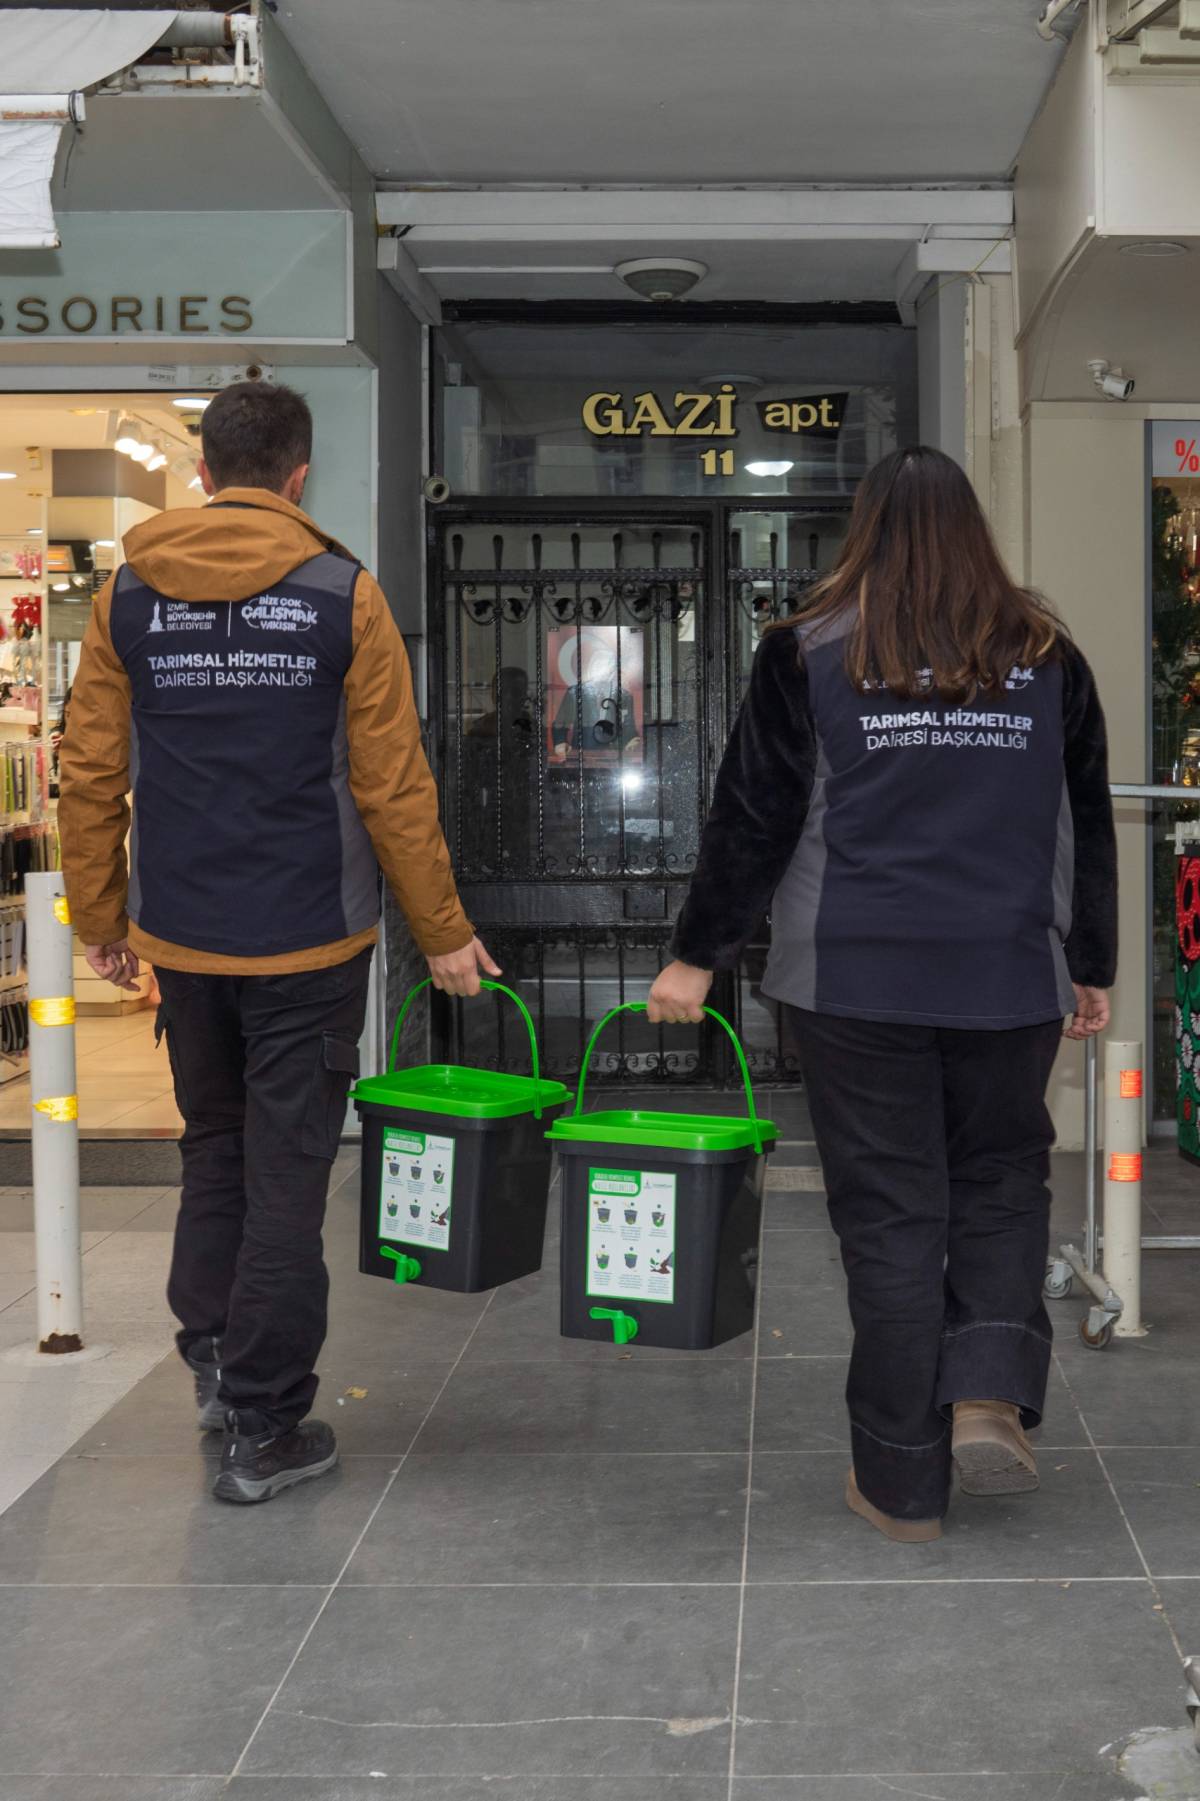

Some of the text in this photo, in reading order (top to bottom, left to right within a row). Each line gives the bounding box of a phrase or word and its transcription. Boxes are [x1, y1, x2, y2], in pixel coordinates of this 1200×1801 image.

[0, 296, 253, 333] SORIES
[582, 384, 840, 436] GAZİ apt.
[700, 449, 734, 476] 11
[167, 602, 189, 611] İZMİR
[258, 594, 302, 609] BİZE ÇOK
[167, 610, 216, 622] BÜYÜKŞEHİR
[241, 606, 318, 624] ÇALIŞMAK
[167, 621, 212, 631] BELEDİYESİ
[260, 621, 297, 632] YAKIŞIR
[148, 649, 317, 670] TARIMSAL HİZMETLER
[155, 669, 312, 688] DAİRESİ BAŞKANLIĞI
[859, 708, 1033, 731] TARIMSAL HİZMETLER
[866, 728, 1027, 750] DAİRESİ BAŞKANLIĞI
